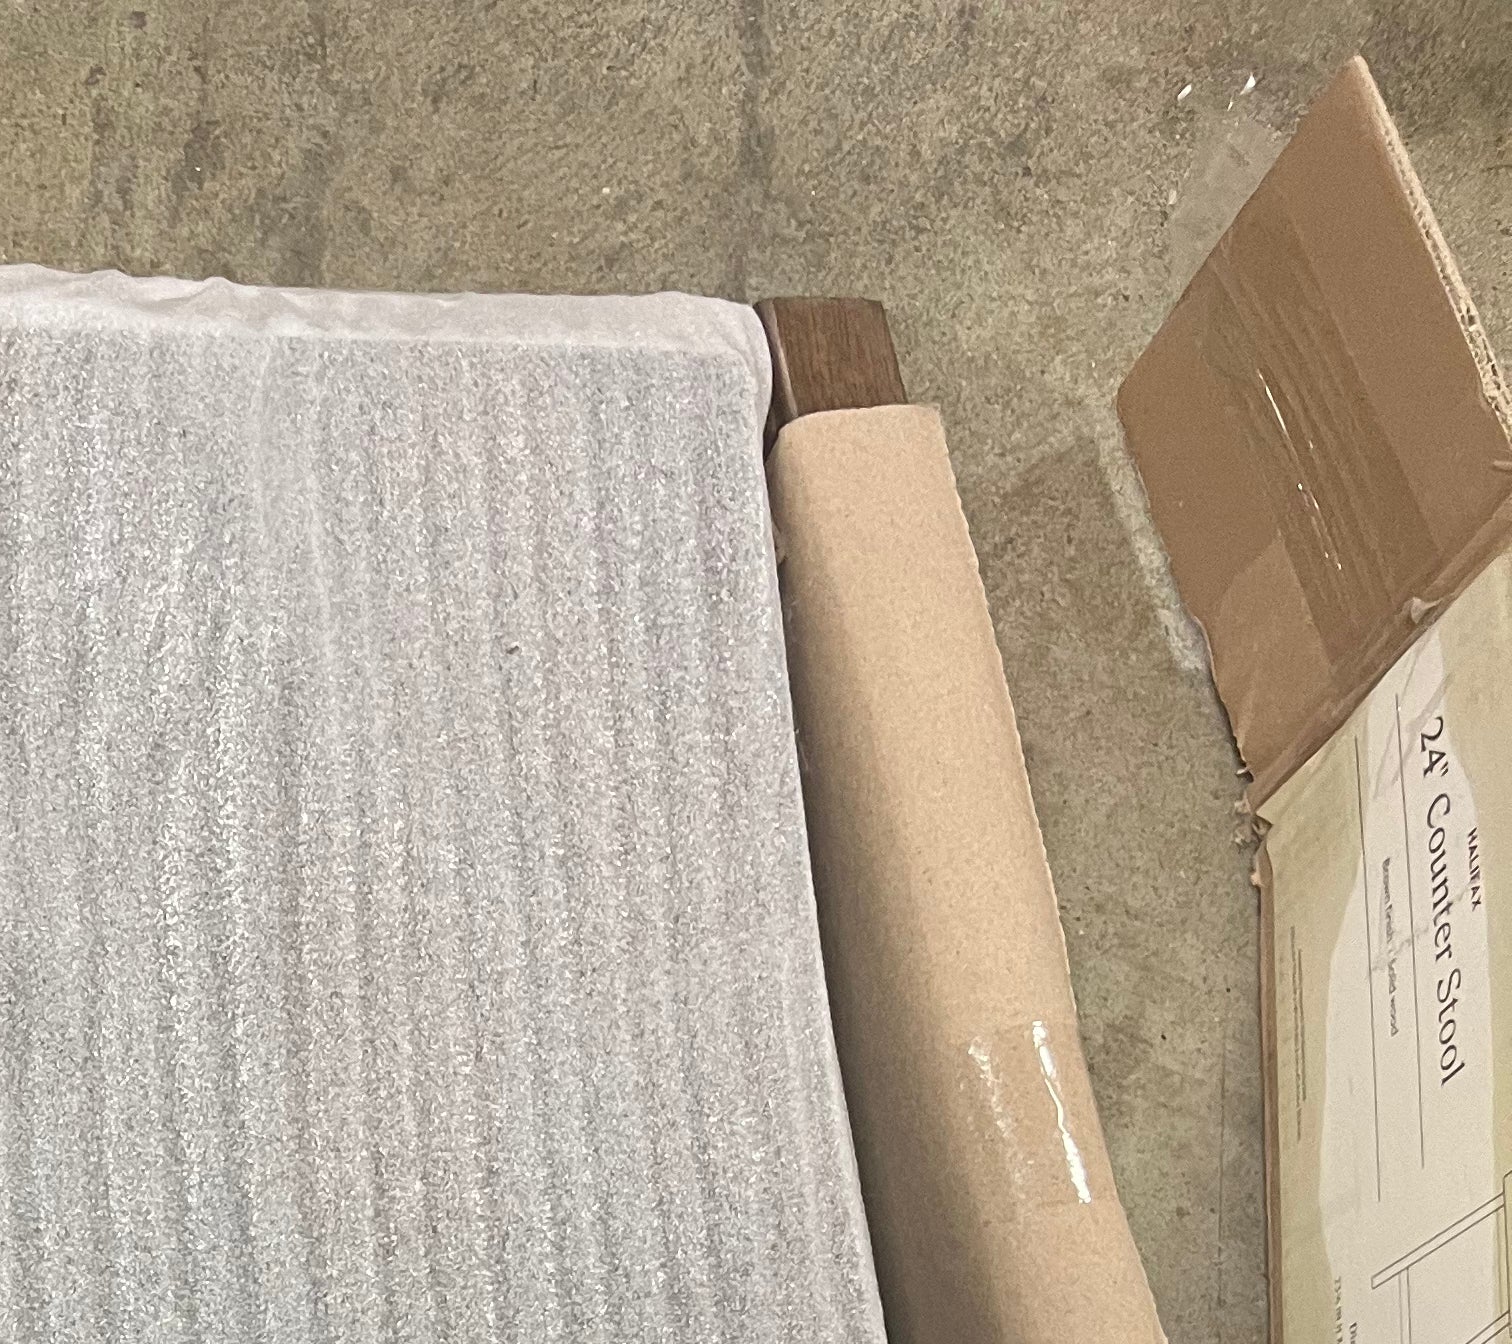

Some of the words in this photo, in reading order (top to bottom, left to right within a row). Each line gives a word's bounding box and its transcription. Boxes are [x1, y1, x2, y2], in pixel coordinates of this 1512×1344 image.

[1419, 716, 1450, 779] 24"
[1426, 792, 1453, 963] Counter
[1466, 826, 1482, 913] HALIFAX
[1435, 967, 1465, 1088] Stool
